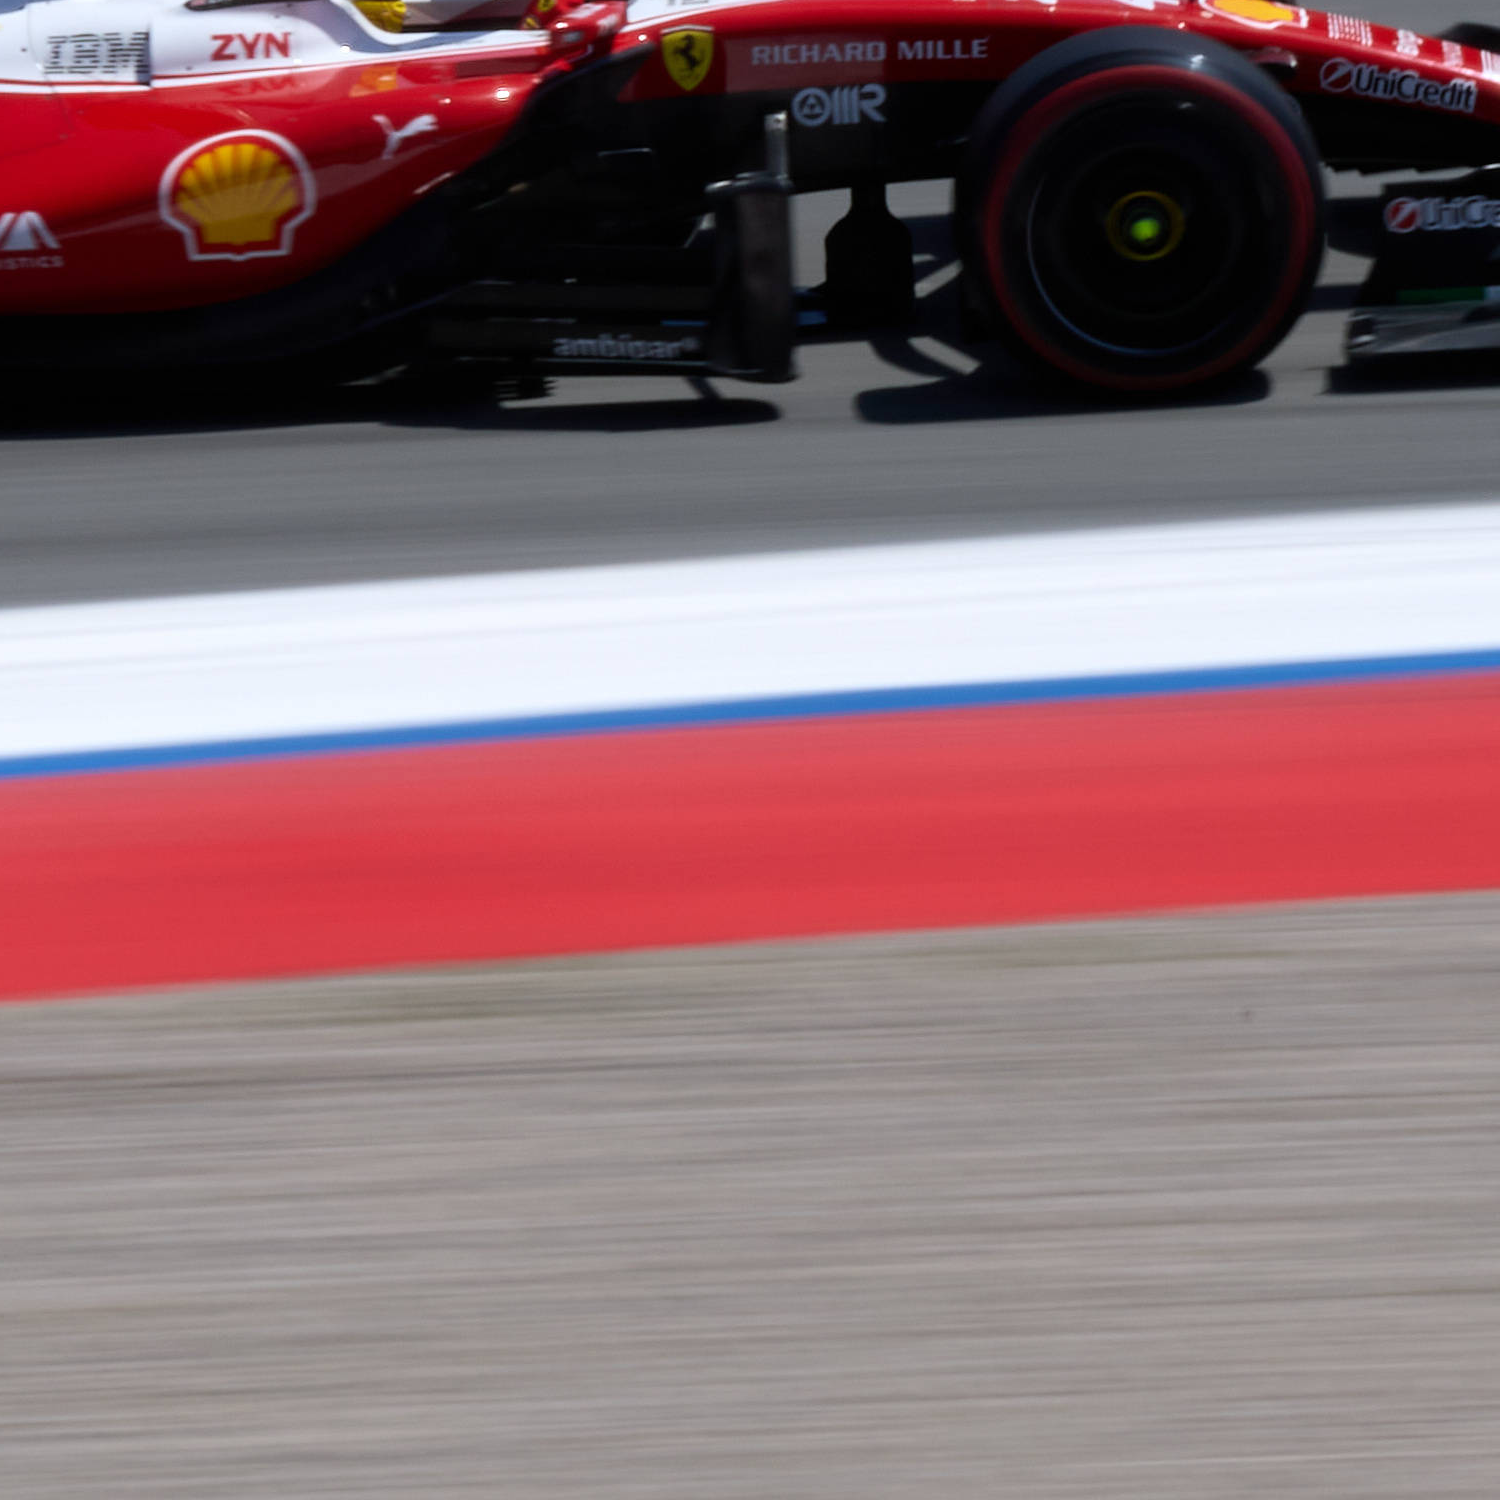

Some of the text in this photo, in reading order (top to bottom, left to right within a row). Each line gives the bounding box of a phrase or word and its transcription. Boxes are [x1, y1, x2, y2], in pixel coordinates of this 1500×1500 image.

[44, 31, 150, 74] IBM
[210, 32, 291, 61] ZYN
[751, 37, 989, 66] RICHARD MILLE
[1352, 61, 1477, 112] UniCredit
